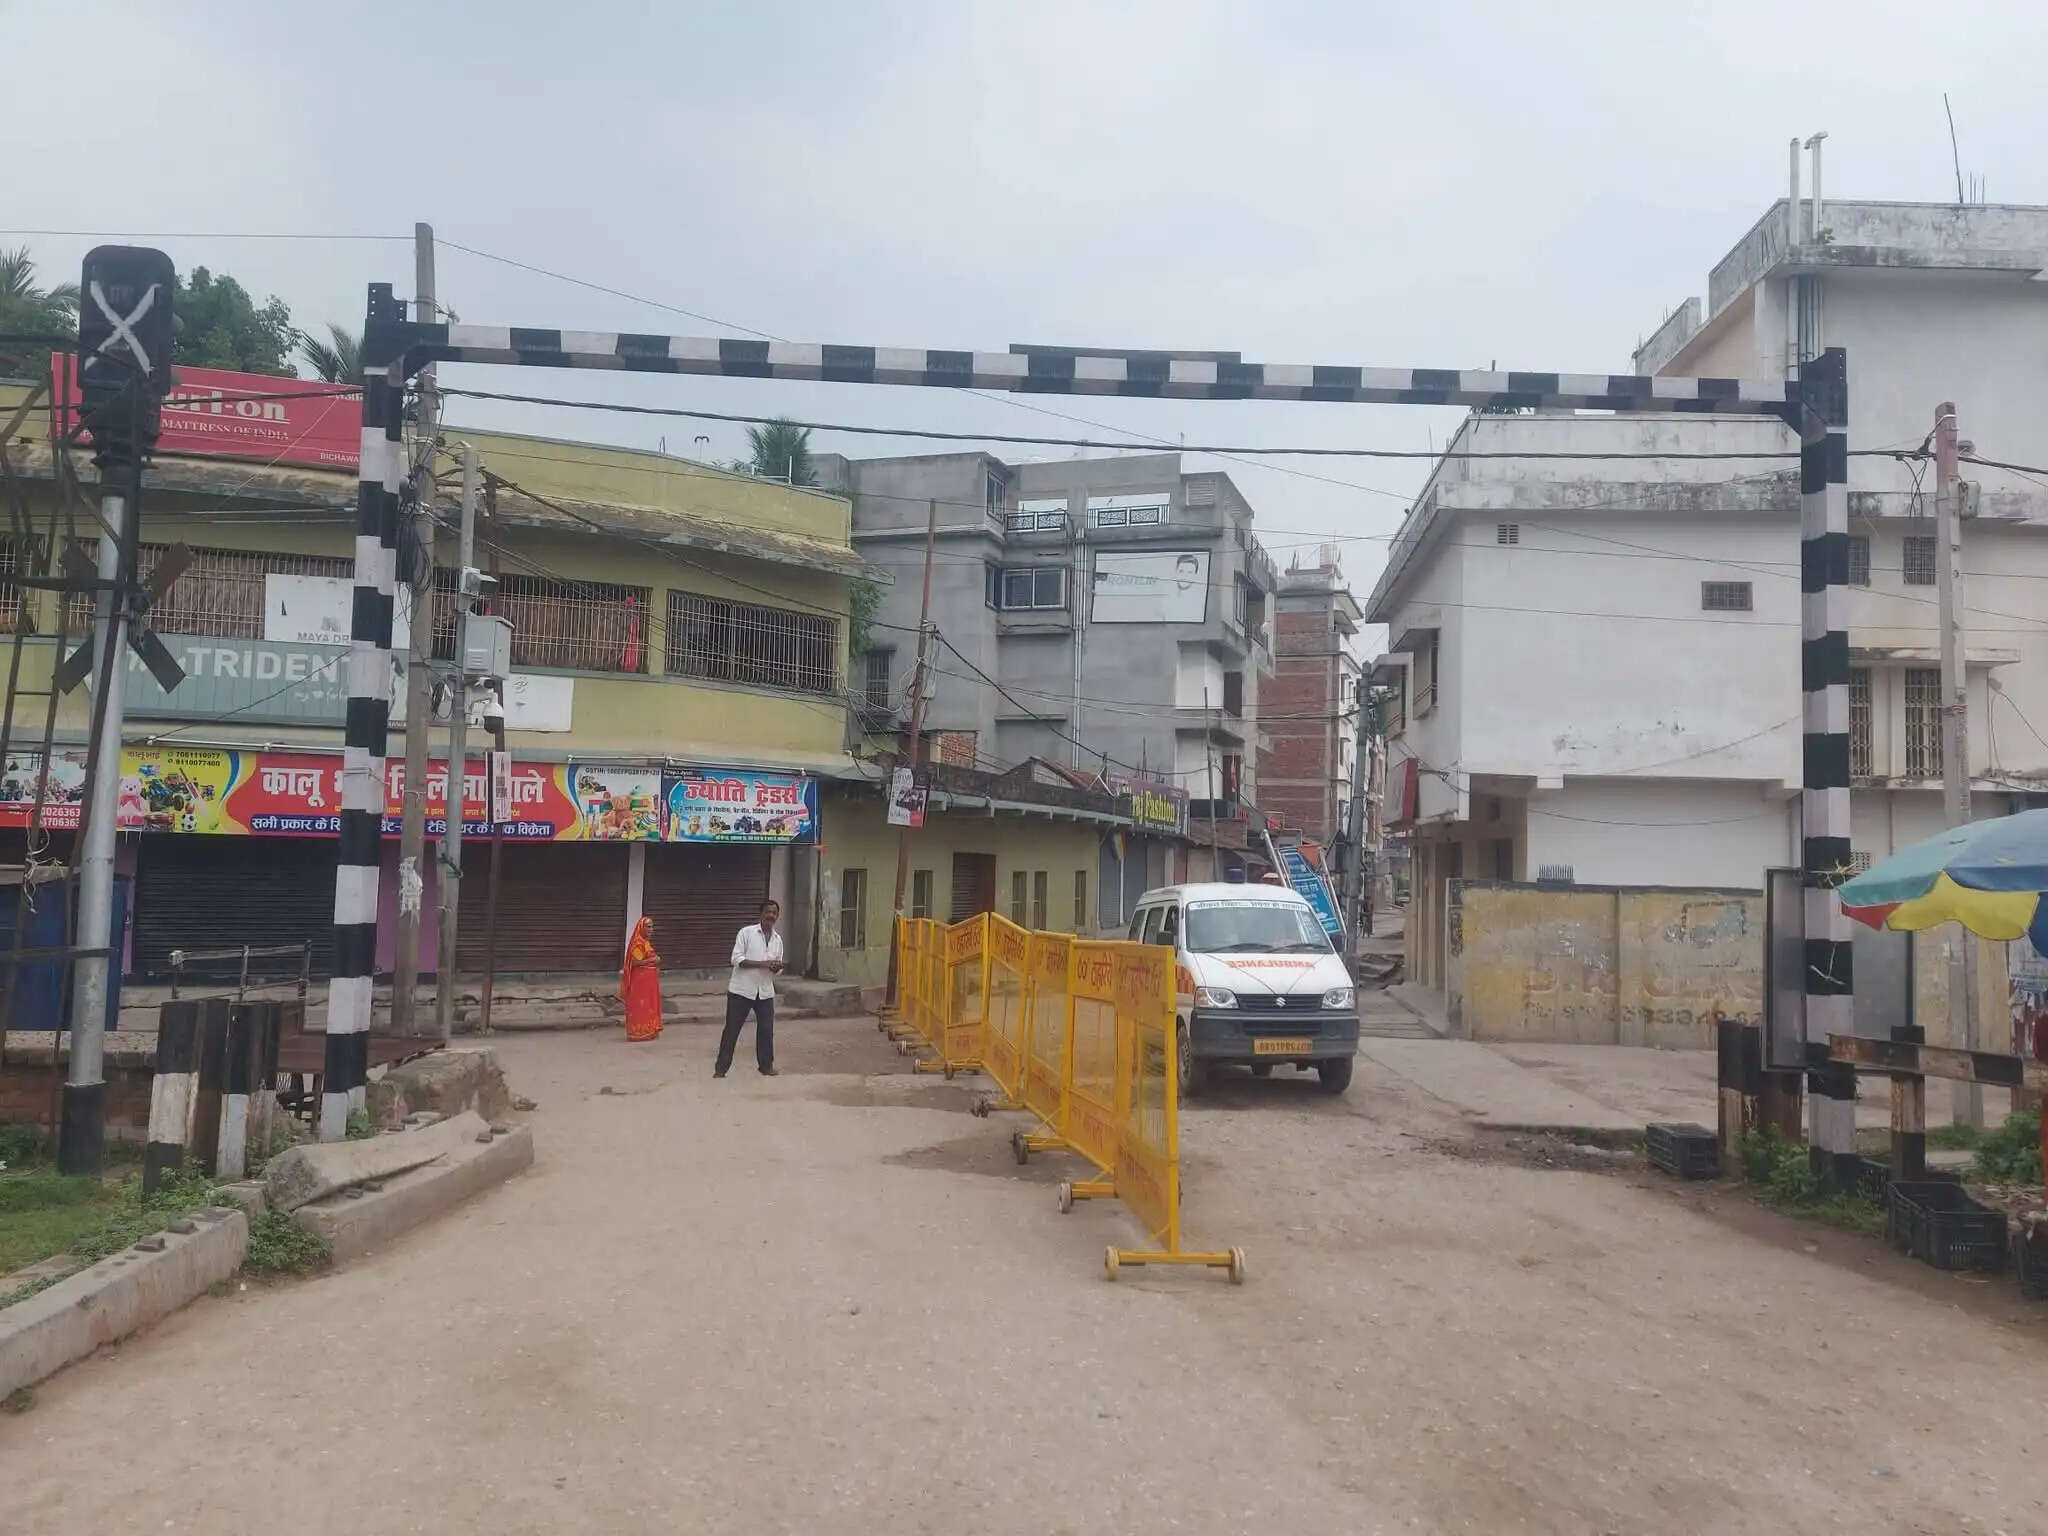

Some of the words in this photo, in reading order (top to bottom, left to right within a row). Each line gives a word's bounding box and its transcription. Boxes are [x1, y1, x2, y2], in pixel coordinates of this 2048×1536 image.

[161, 391, 286, 420] url-on
[161, 418, 232, 433] MATTRESS
[234, 425, 252, 434] OF
[253, 427, 289, 440] INDIA
[298, 632, 329, 642] MAYA
[261, 767, 325, 807] कालू
[683, 777, 747, 803] ज्योति
[755, 780, 800, 807] ट्रेडर्स
[1145, 791, 1175, 822] Fashion
[252, 816, 277, 830] सभी
[280, 817, 313, 831] प्रकार
[314, 817, 328, 831] के
[517, 822, 550, 836] विक्रेता
